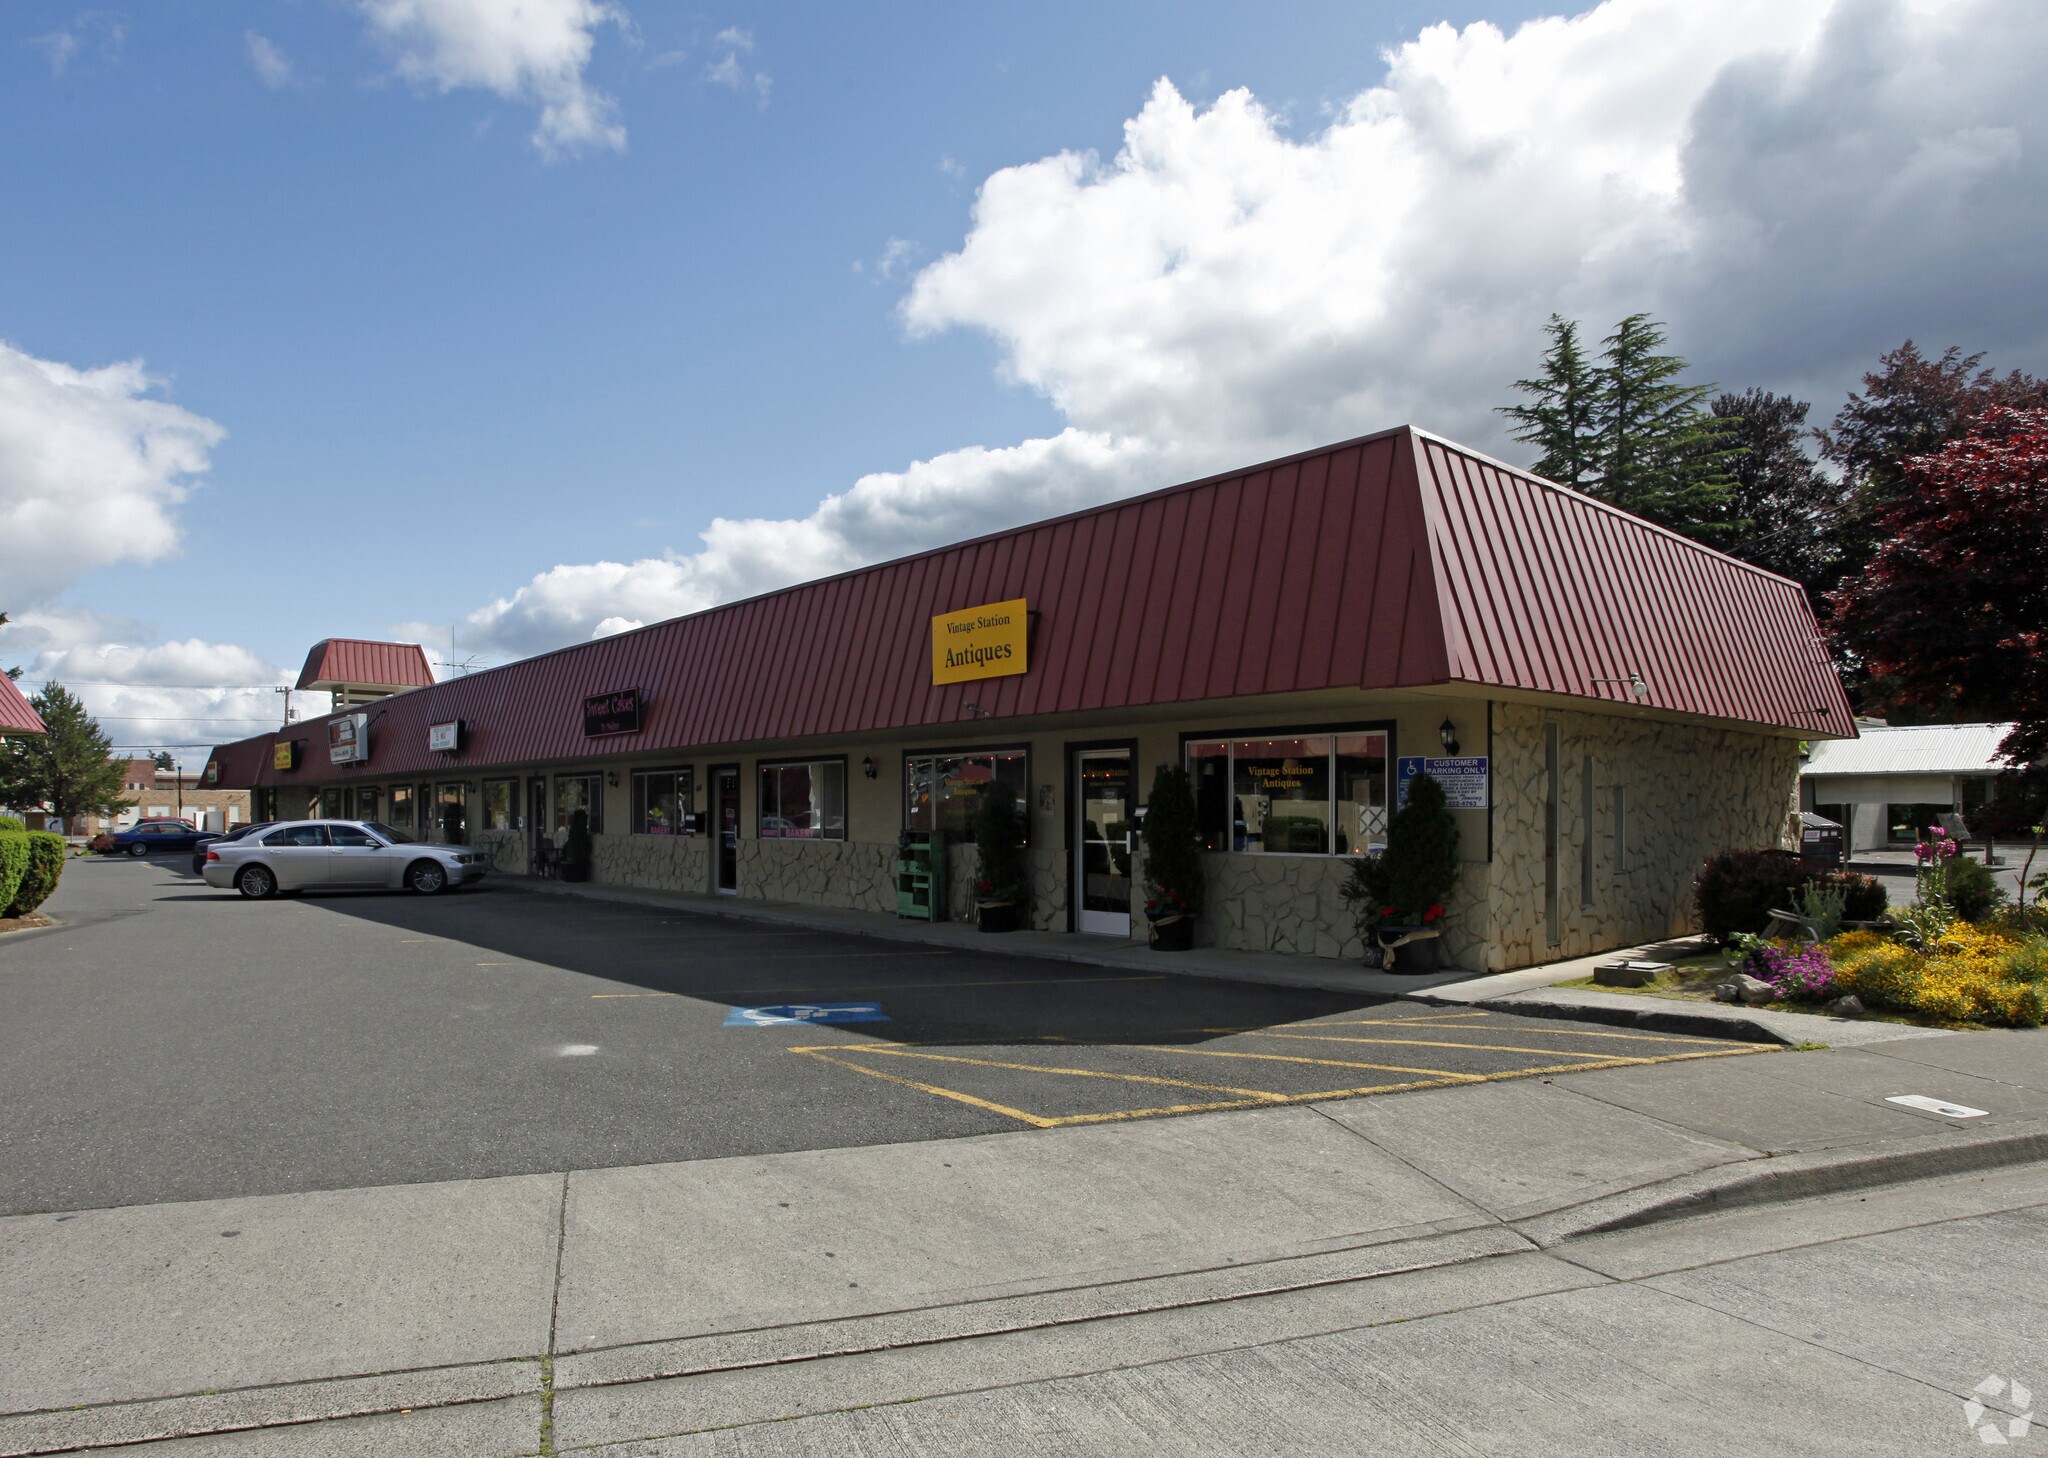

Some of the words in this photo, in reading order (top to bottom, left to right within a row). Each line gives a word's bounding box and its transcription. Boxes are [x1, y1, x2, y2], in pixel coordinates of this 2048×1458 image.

[947, 622, 975, 634] Vintage
[977, 614, 1011, 629] Station
[945, 643, 1012, 668] Antiques
[586, 698, 609, 717] Sweet
[612, 692, 634, 714] Cakes
[1248, 766, 1280, 776] Vintage
[1282, 765, 1314, 775] Station
[1463, 766, 1486, 774] ONLY
[1263, 778, 1301, 789] Antiques
[650, 826, 670, 834] BAKERY
[785, 828, 814, 837] BAKERY
